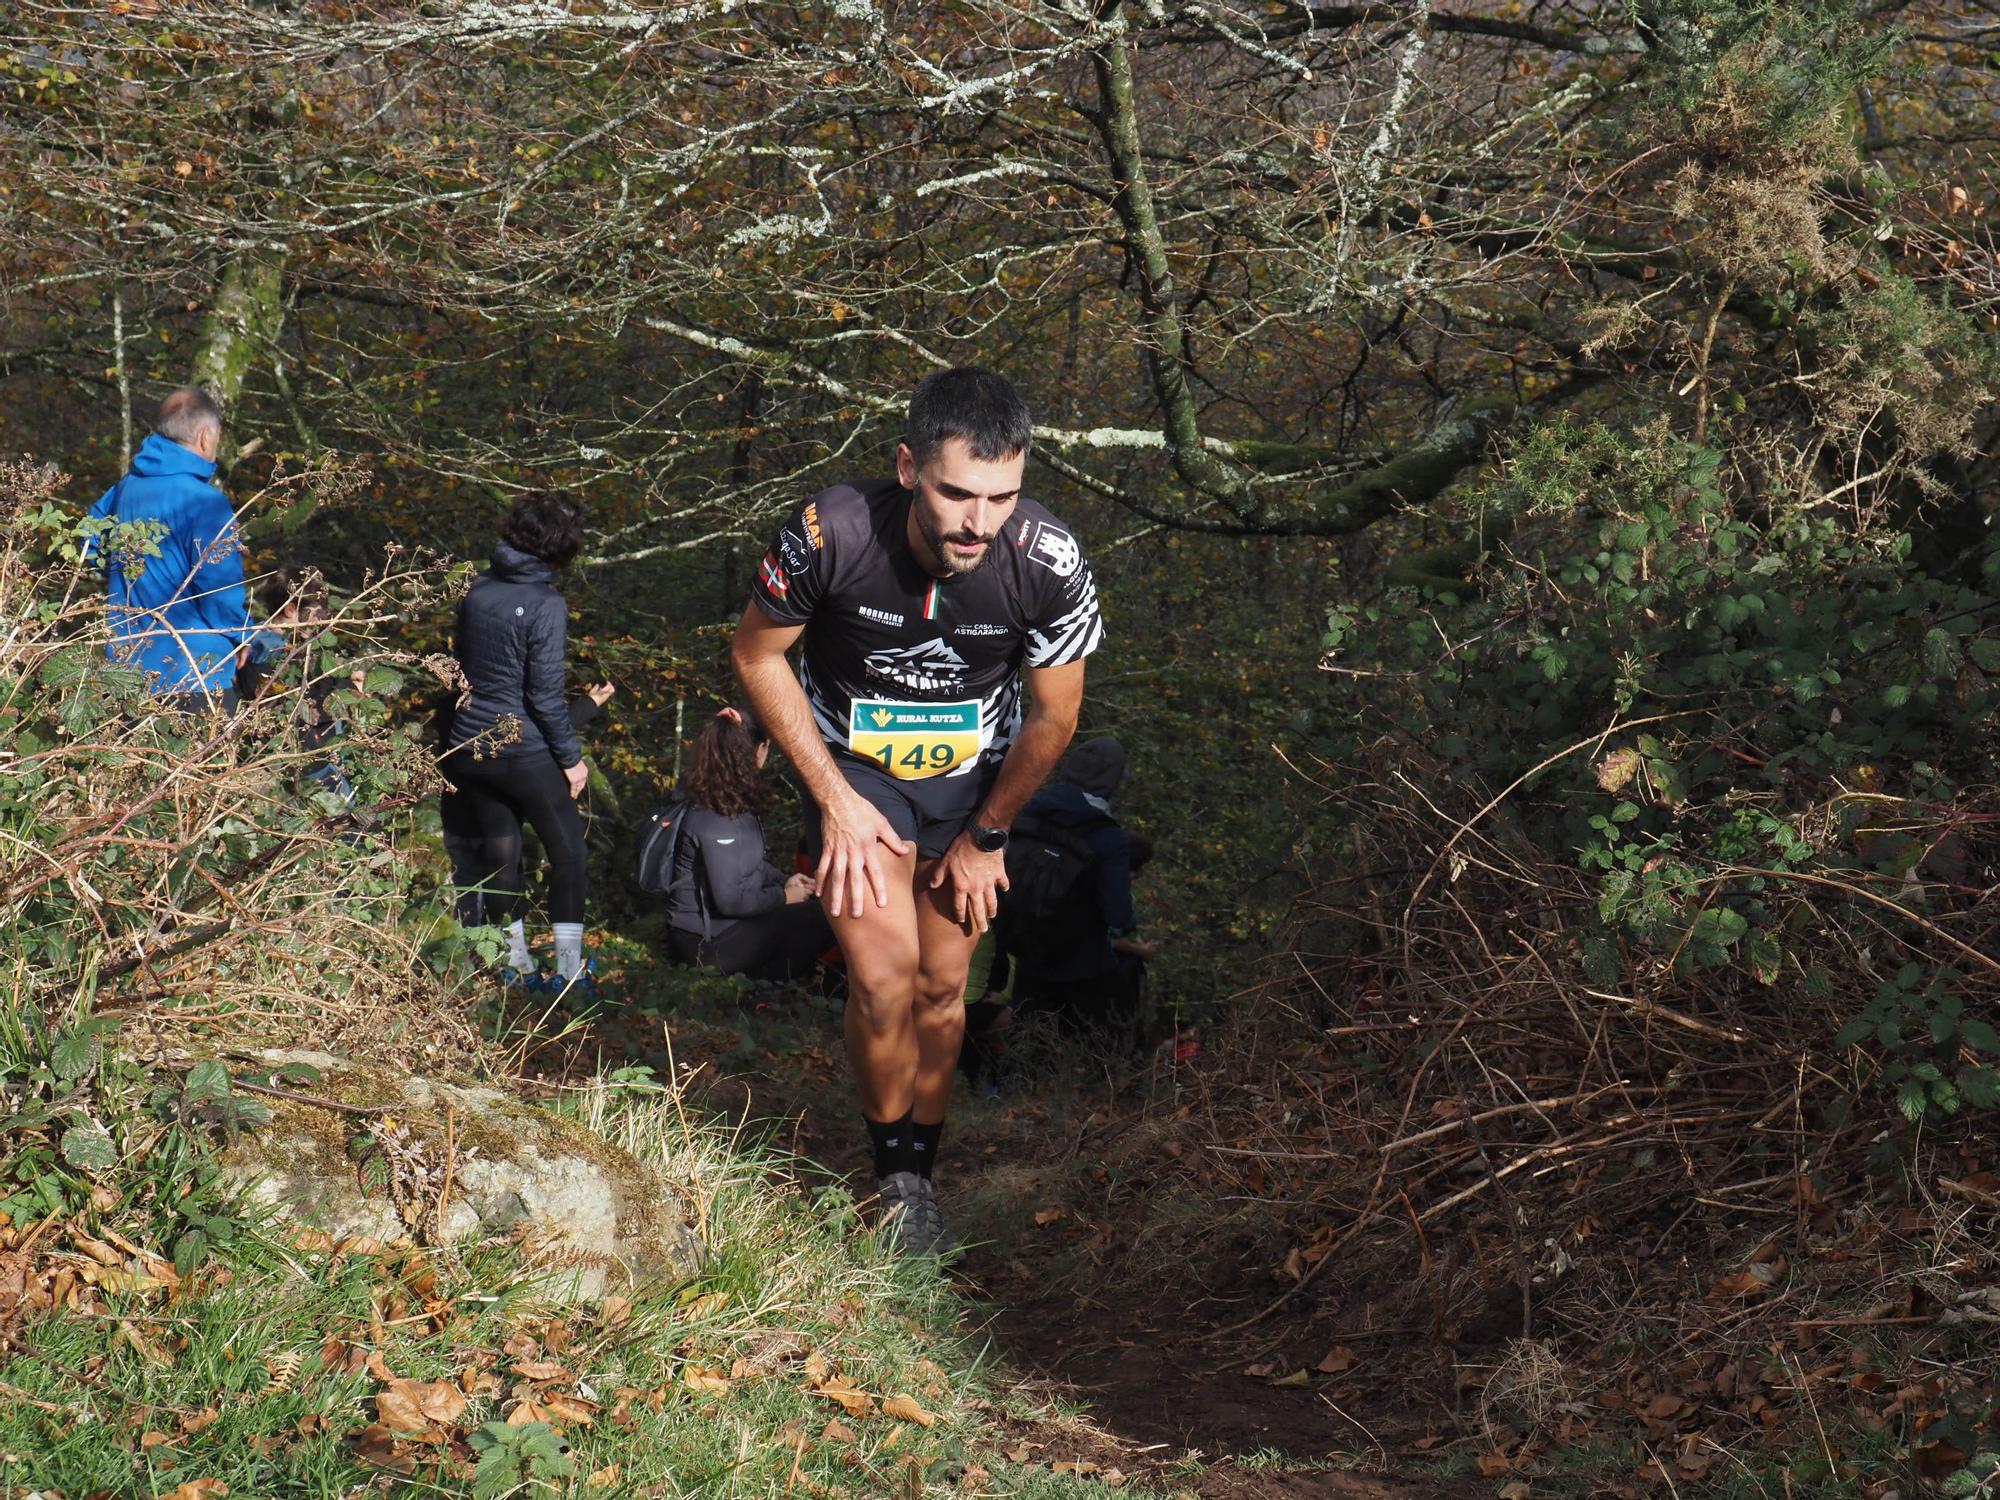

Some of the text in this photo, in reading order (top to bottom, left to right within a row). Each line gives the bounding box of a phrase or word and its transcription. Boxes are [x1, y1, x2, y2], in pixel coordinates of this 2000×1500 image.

[858, 605, 904, 624] MORKAIKO
[896, 713, 964, 723] RURAL KUTXA
[876, 743, 955, 770] 149
